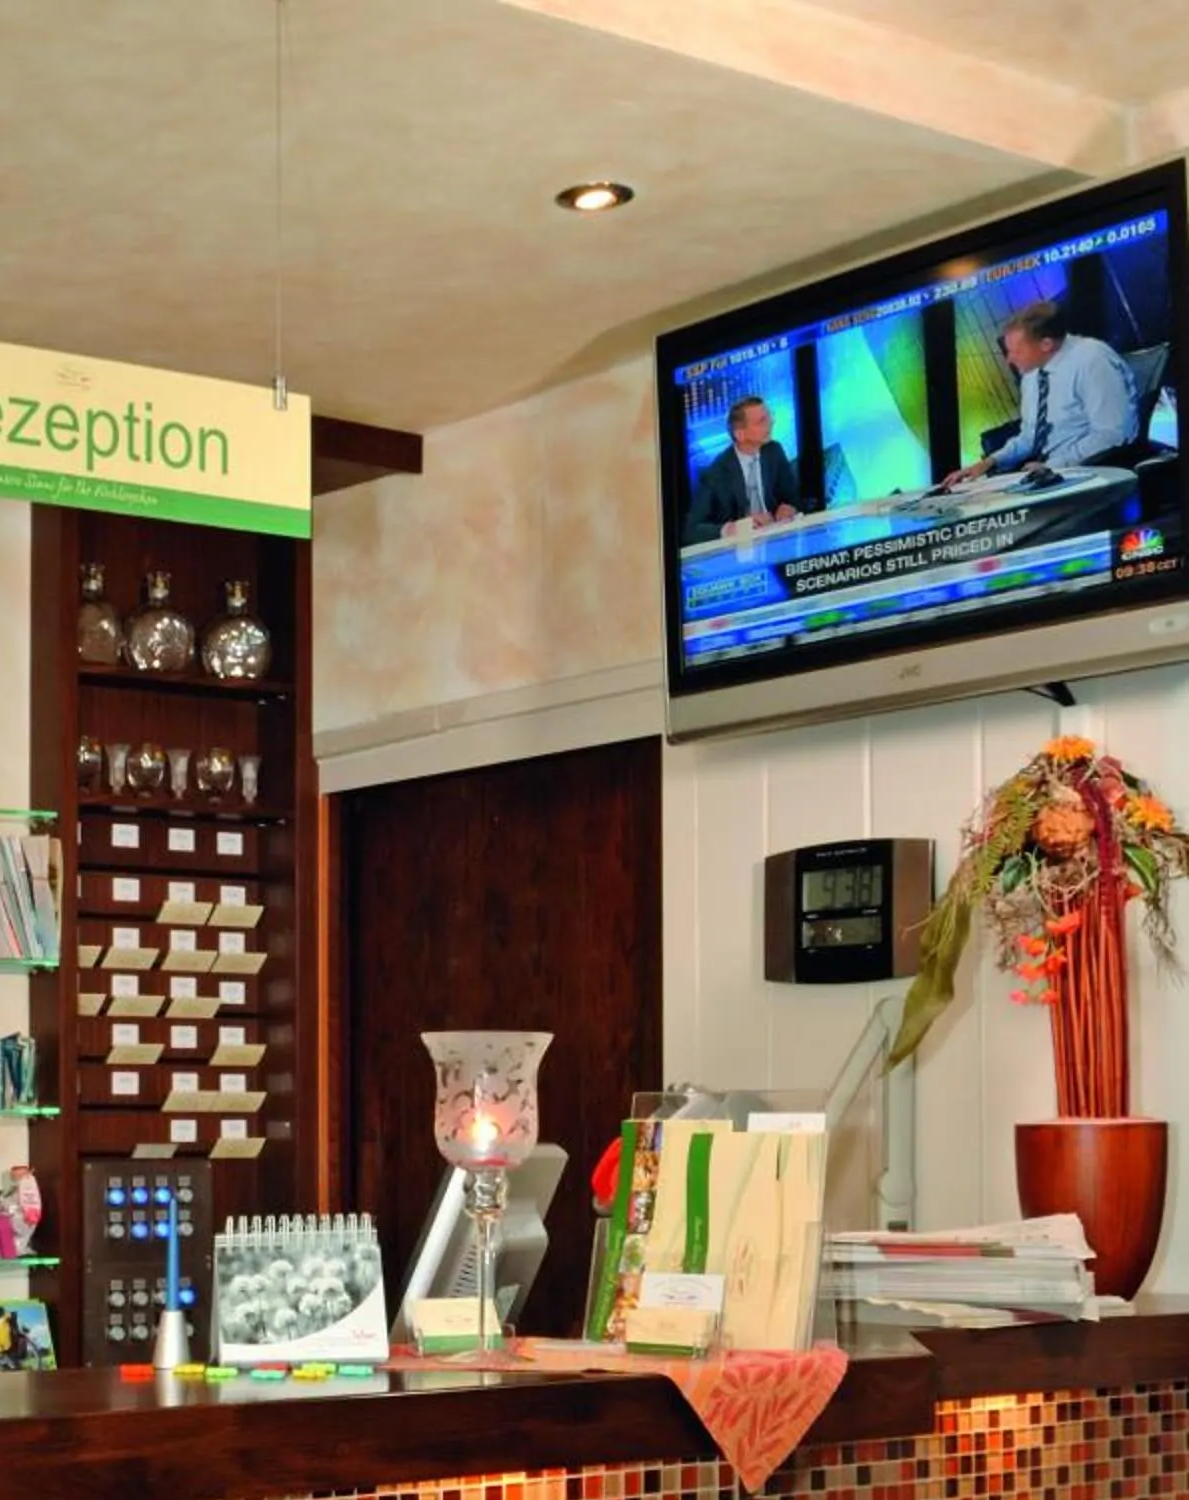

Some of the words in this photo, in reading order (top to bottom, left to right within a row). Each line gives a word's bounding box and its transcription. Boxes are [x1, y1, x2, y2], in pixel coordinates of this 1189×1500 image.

[785, 551, 851, 578] BIERNAT:
[853, 527, 953, 561] PESSIMISTIC
[955, 508, 1030, 542] DEFAULT
[795, 562, 883, 593] SCENARIOS
[885, 552, 929, 573] STILL
[931, 536, 993, 561] PRICED
[996, 532, 1014, 549] IN
